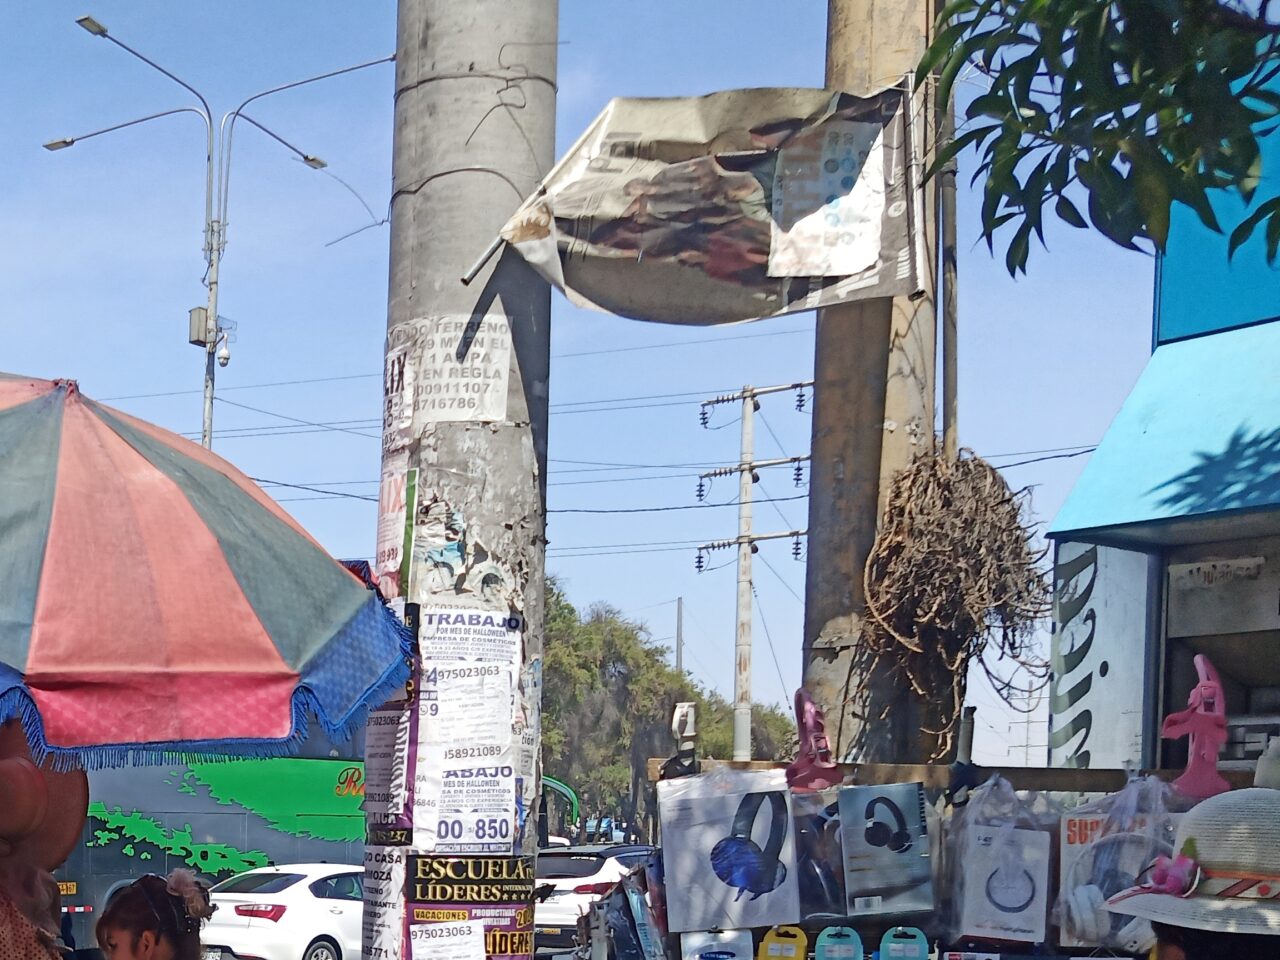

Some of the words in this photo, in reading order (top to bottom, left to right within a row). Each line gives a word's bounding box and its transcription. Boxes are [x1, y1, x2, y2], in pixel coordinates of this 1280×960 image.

[435, 321, 508, 335] TERRENO
[490, 340, 509, 350] EL
[423, 369, 443, 379] EN
[448, 367, 502, 380] REGLA
[424, 613, 520, 630] TRABAJO
[473, 628, 506, 638] HALLOWEEN
[472, 637, 517, 646] COSMÉTICOS
[438, 665, 500, 681] 975023063
[443, 780, 455, 788] MES
[466, 779, 500, 787] HALLOWEEN
[475, 819, 509, 839] 850
[375, 853, 403, 864] CASA
[415, 857, 525, 880] ESCUELA
[414, 880, 501, 901] LÍDERES
[415, 911, 468, 921] VACACIONES
[411, 926, 472, 940] 975023063
